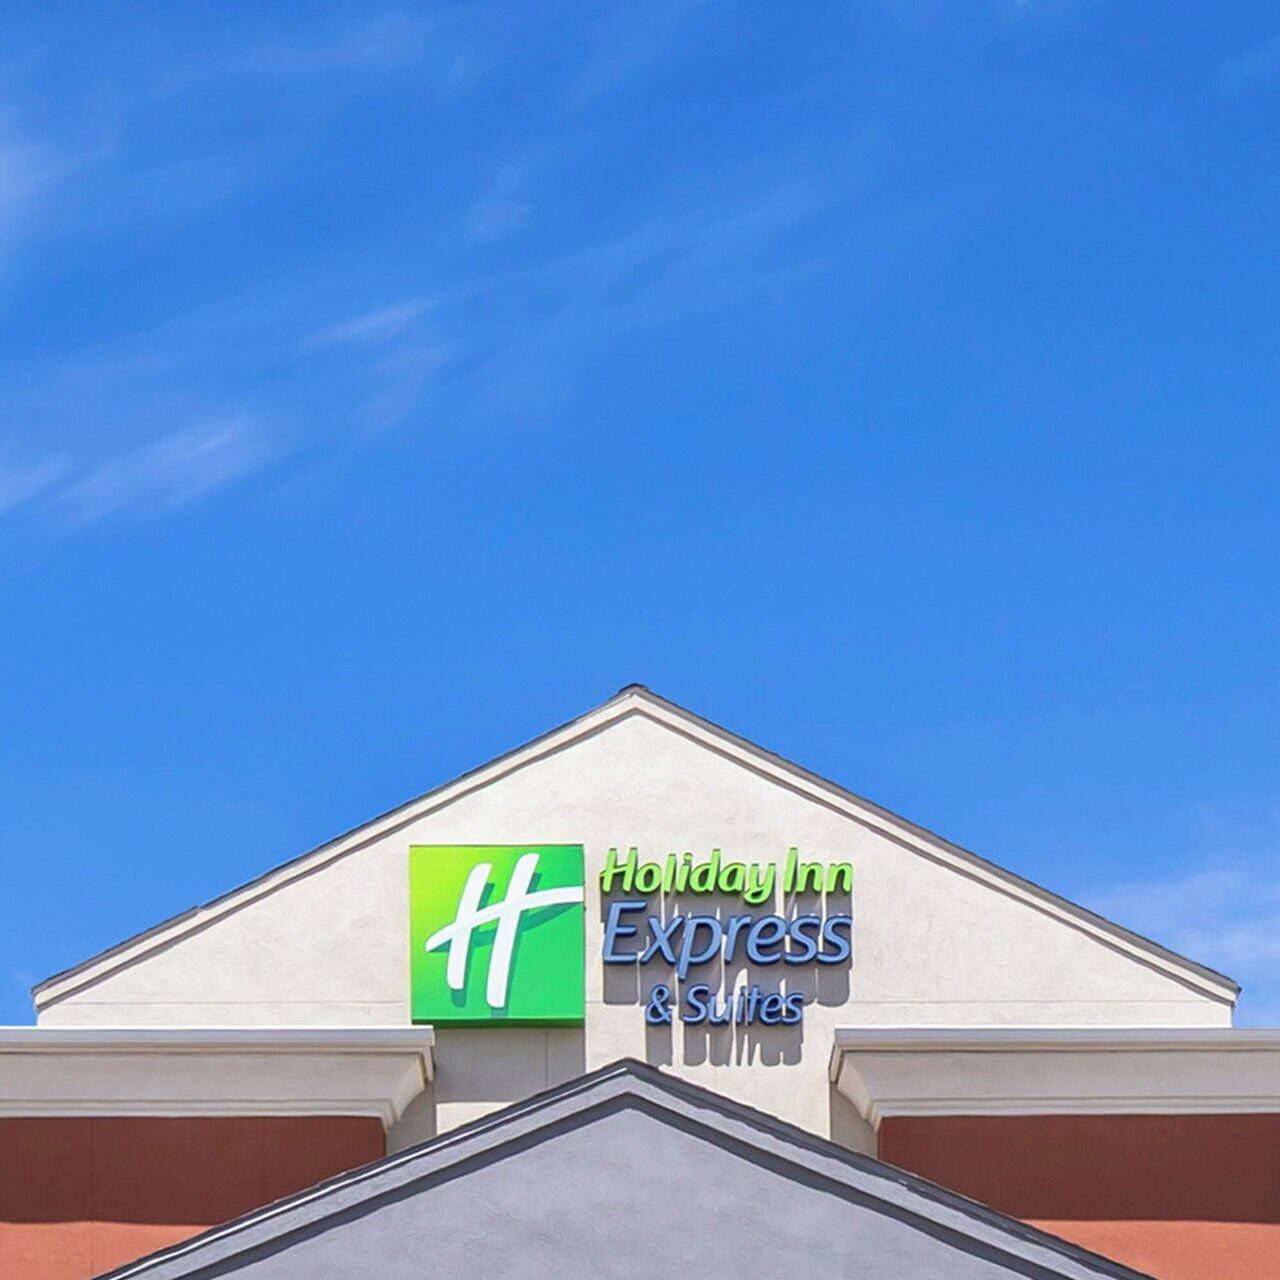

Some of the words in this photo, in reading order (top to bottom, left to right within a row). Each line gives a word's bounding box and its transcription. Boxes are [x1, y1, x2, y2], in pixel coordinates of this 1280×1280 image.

[600, 847, 776, 903] Holiday
[783, 847, 854, 894] Inn
[602, 900, 853, 980] Express
[644, 983, 673, 1025] &
[680, 983, 804, 1025] Suites
